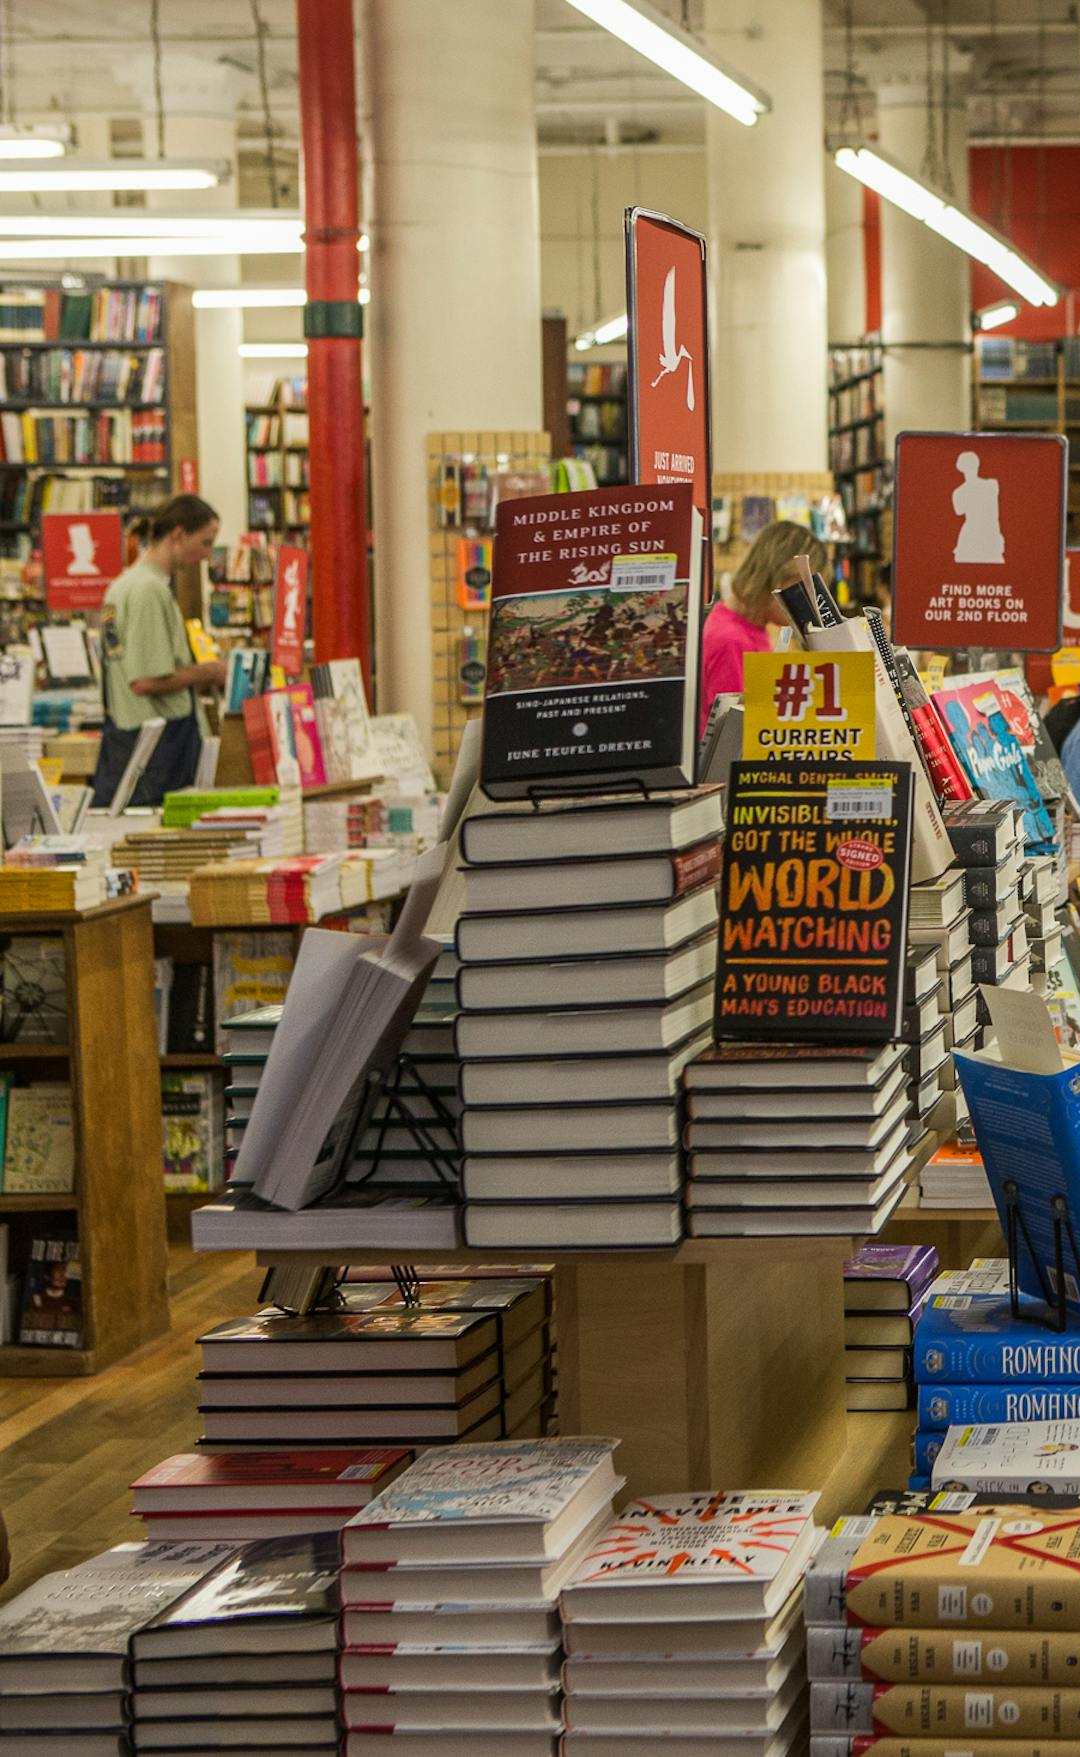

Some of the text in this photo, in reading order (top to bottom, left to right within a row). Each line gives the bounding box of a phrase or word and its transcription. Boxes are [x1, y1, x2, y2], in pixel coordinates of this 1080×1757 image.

[654, 451, 695, 474] JUST ARRIVED
[514, 500, 674, 526] MIDDLE KINGDOM
[533, 521, 652, 543] & EMPIRE OF
[517, 540, 665, 564] THE RISING SUN
[942, 584, 1012, 597] FIND MORE
[929, 597, 1024, 609] ART BOOKS ON
[925, 609, 1028, 622] OUR 2ND FLOOR
[773, 663, 848, 722] #1
[516, 695, 590, 709] SINO-JAPANESE
[536, 705, 626, 719] PAST AND PRESENT
[758, 728, 862, 747] CURRENT
[507, 740, 652, 761] JUNE TEUFEL DREYER
[767, 750, 855, 761] AFFAIRS
[739, 771, 792, 784] MYCHAL
[732, 831, 771, 852] GOT
[779, 831, 817, 852] THE
[840, 848, 880, 863] SIGNED
[728, 858, 895, 912] WORLD
[724, 916, 892, 951] WATCHING
[723, 974, 887, 995] A YOUNG BLACK
[721, 999, 888, 1018] MAN'S EDUCATION
[976, 1479, 1005, 1492] SICK
[690, 1495, 746, 1506] THE
[619, 1505, 806, 1520] INEVITABLE
[600, 1555, 757, 1570] KEVIN KELLY
